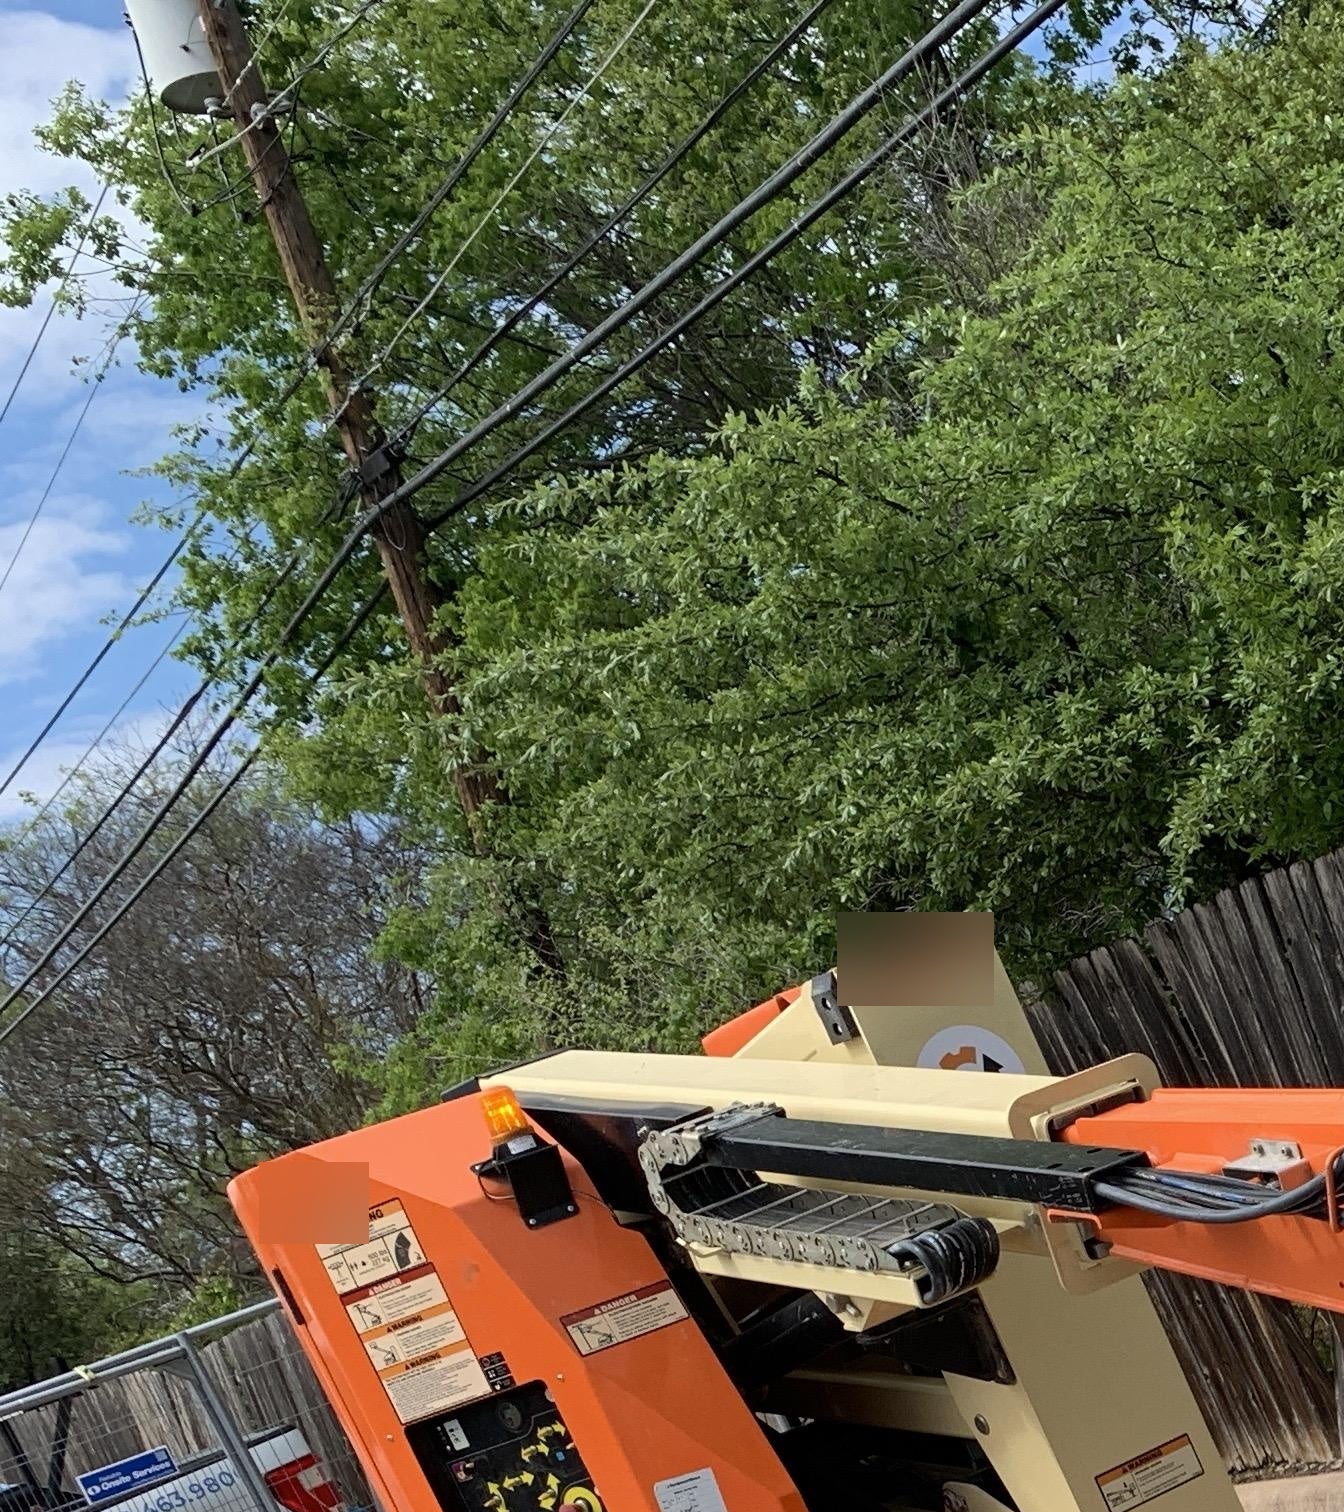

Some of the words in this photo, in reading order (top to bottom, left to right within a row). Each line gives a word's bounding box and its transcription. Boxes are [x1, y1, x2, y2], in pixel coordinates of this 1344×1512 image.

[600, 1294, 638, 1312] DANGER
[410, 1352, 441, 1368] WARNING
[133, 1460, 171, 1480] Services
[1127, 1450, 1164, 1471] WARNING
